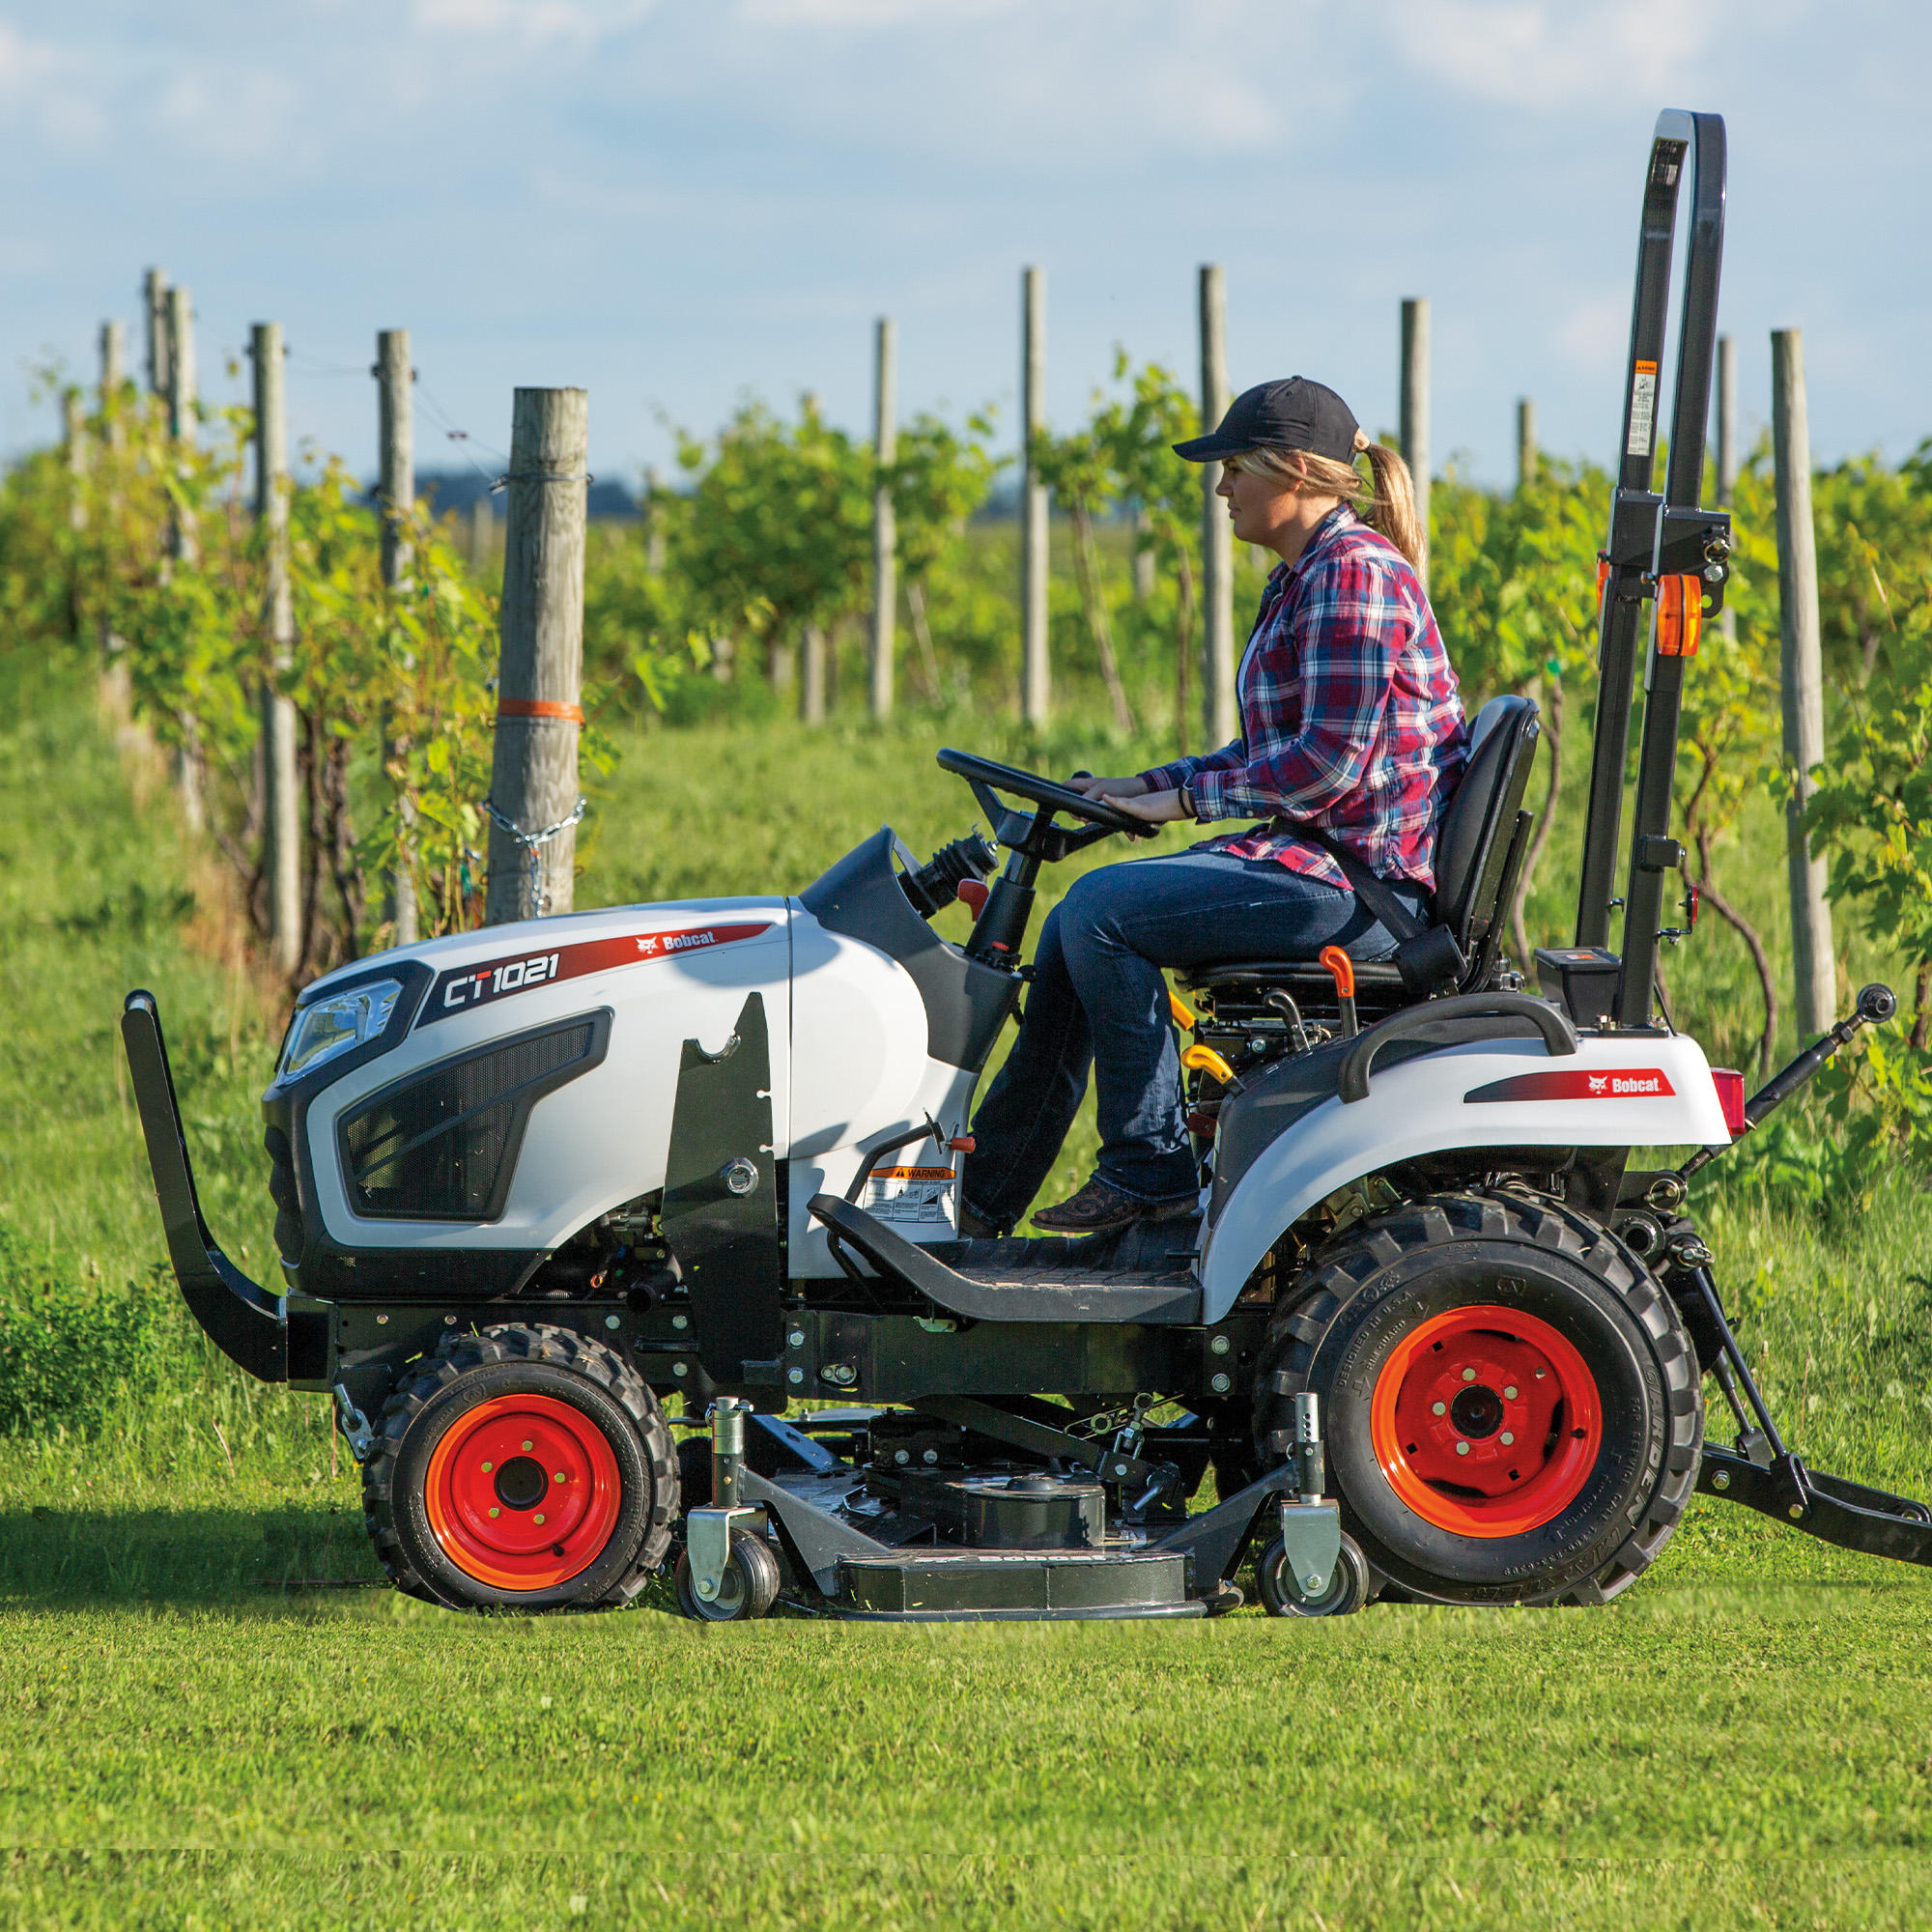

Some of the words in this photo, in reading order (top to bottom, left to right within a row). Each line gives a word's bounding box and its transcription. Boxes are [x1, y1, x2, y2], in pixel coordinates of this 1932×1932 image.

[662, 931, 715, 951] Bobcat
[443, 952, 560, 1008] CT1021
[1612, 1077, 1660, 1094] Bobcat
[907, 1169, 946, 1178] WARNING
[1338, 1331, 1369, 1388] DESIGNED
[1626, 1363, 1665, 1524] GARDEN
